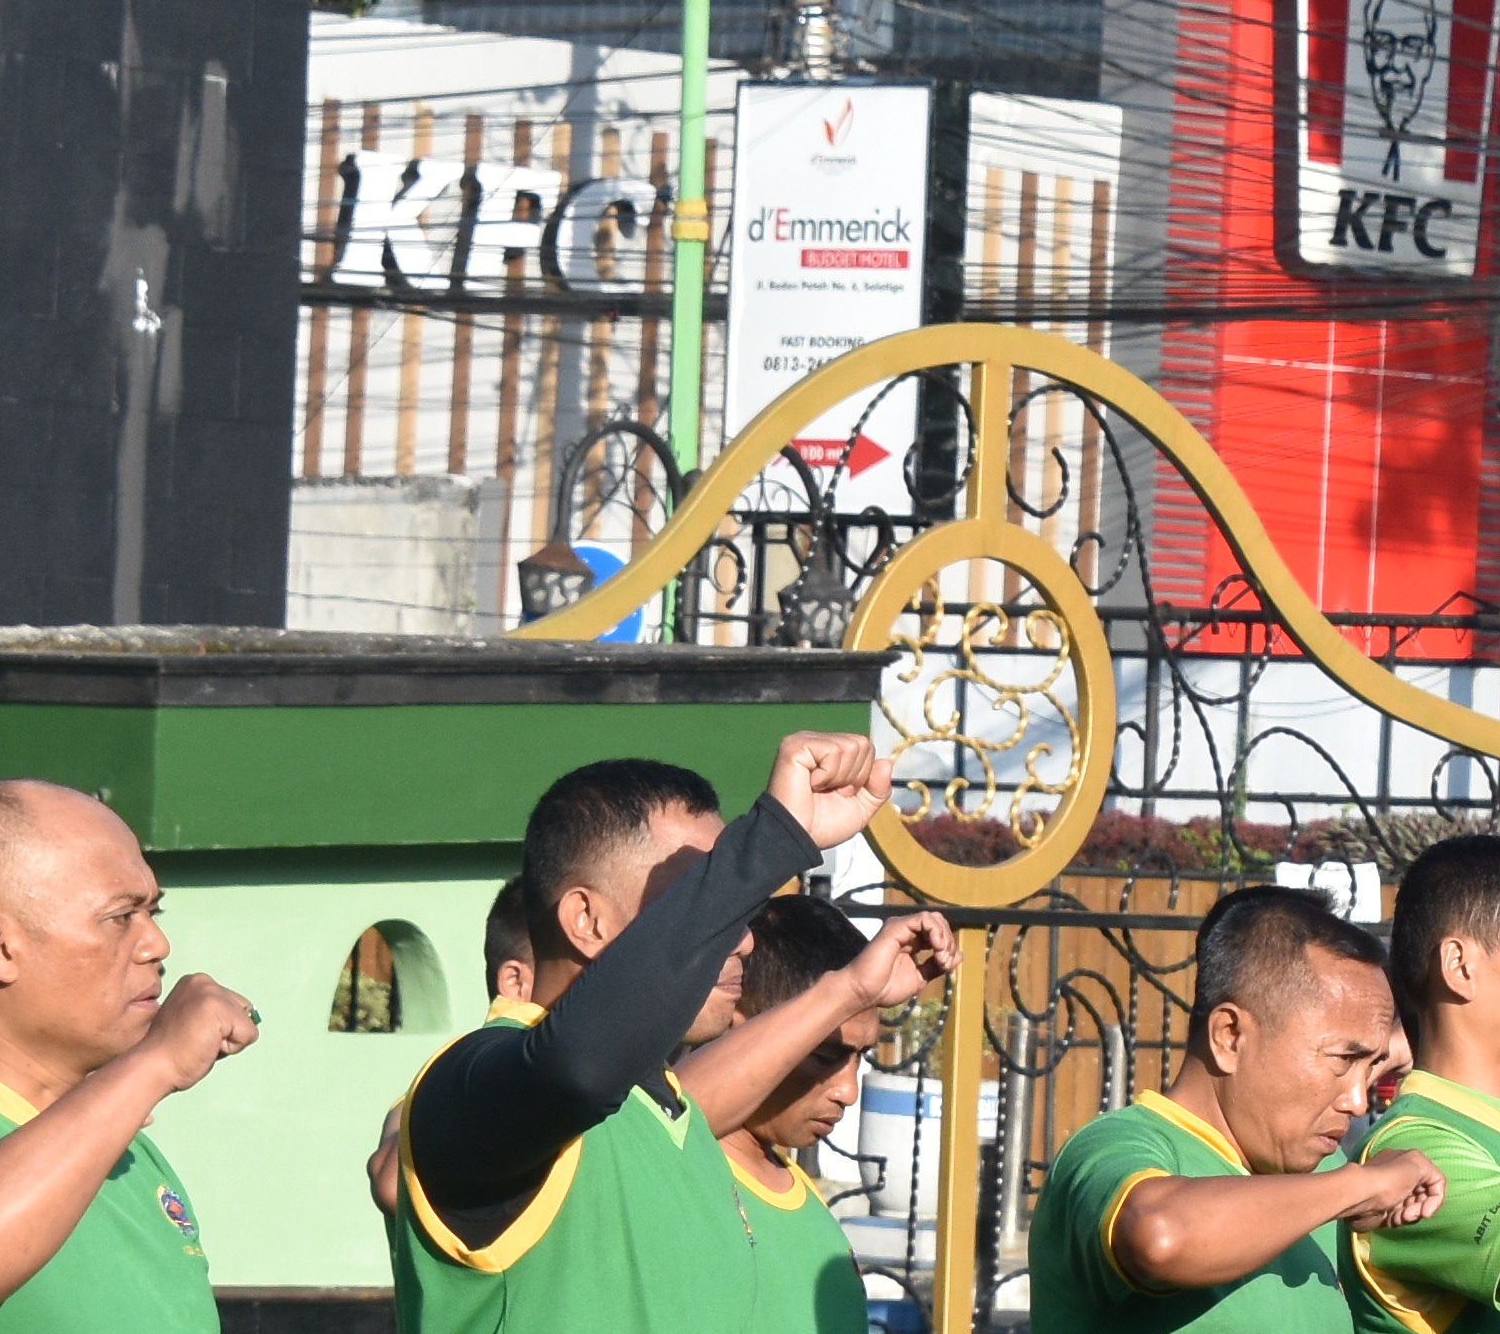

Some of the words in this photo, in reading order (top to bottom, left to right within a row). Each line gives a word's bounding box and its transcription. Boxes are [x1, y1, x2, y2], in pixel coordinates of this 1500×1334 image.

[330, 149, 668, 295] KFC
[747, 206, 912, 244] d'Emmerick
[1328, 188, 1453, 259] KFC
[807, 251, 857, 267] BUDGET
[861, 251, 901, 267] HOTEL
[781, 336, 805, 347] FAST
